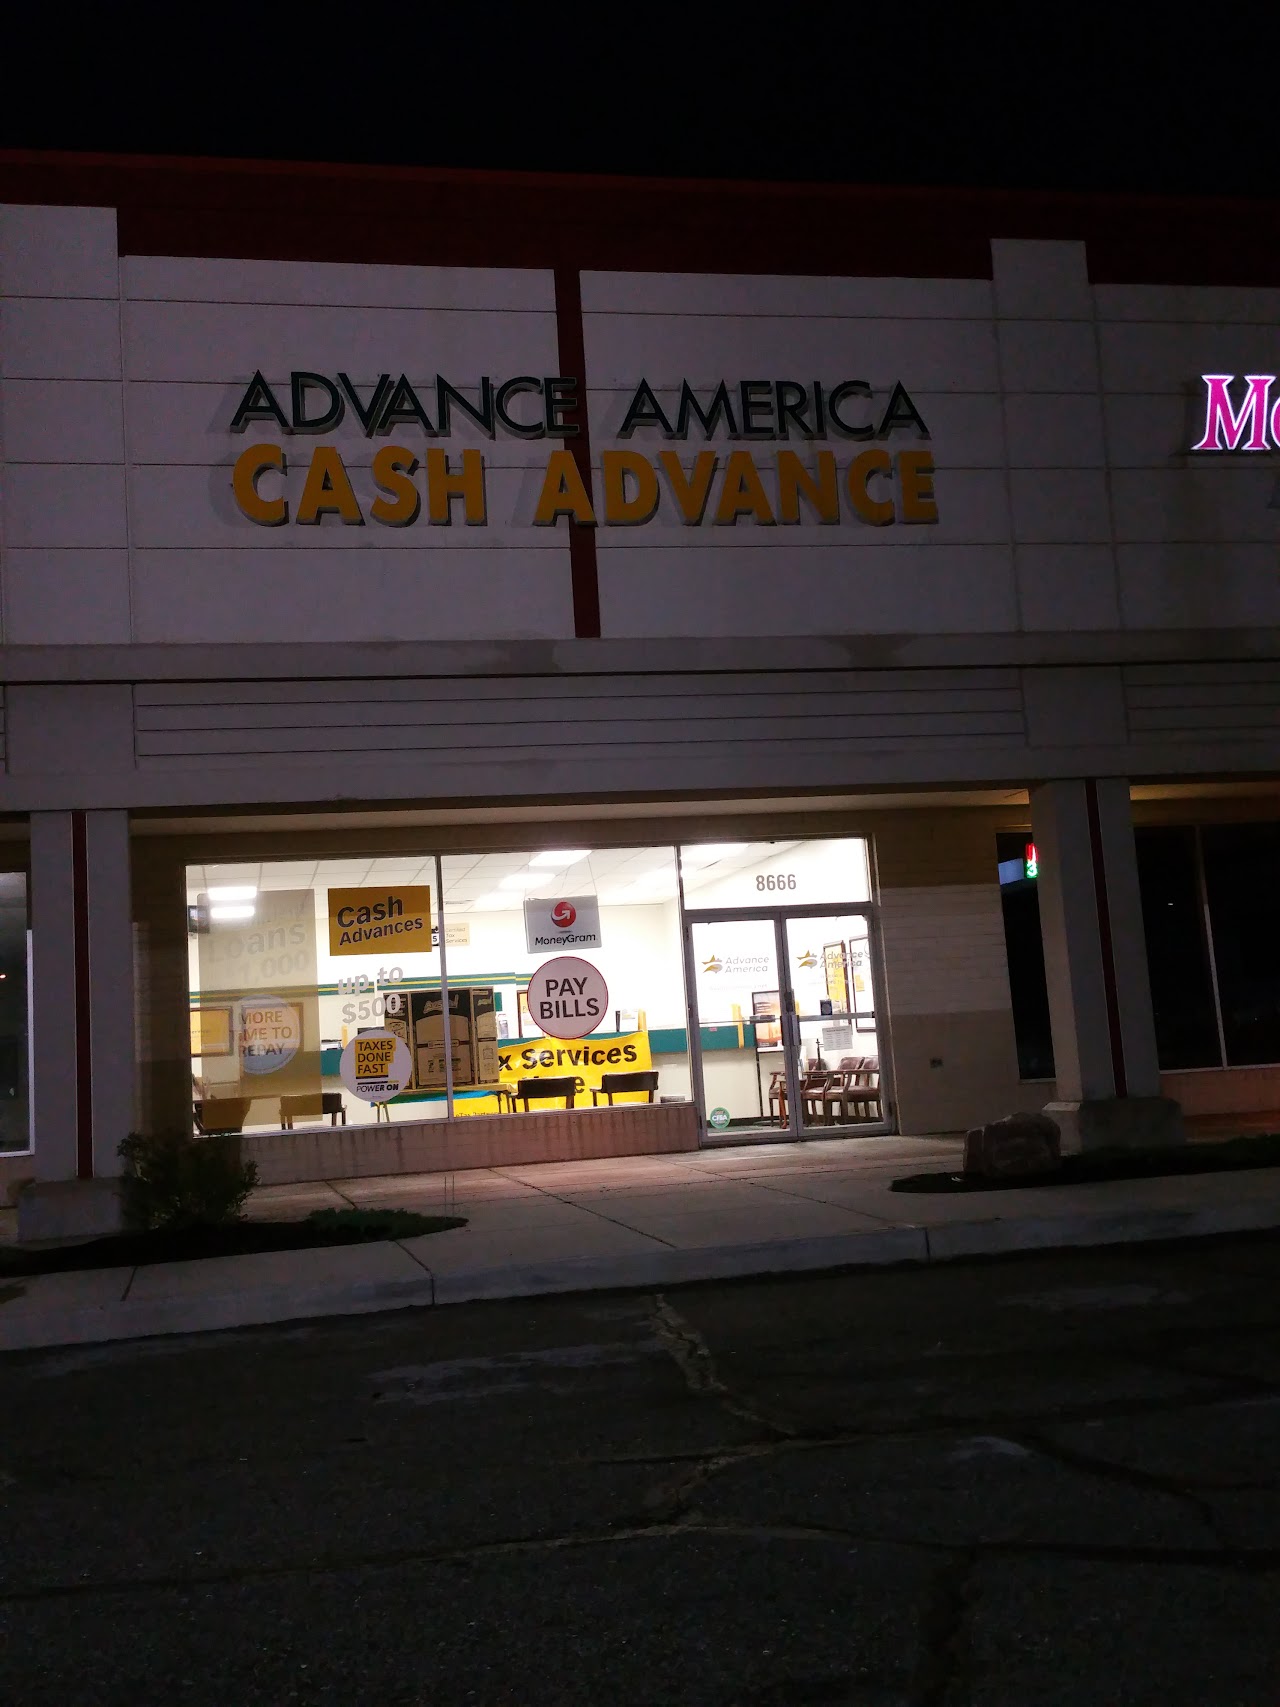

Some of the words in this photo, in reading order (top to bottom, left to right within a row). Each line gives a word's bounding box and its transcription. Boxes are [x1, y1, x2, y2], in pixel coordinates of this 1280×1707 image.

[230, 370, 580, 439] ADVANCE
[617, 376, 931, 441] AMERICA
[1190, 374, 1280, 450] M
[231, 443, 488, 528] CASH
[532, 447, 939, 528] ADVANCE
[755, 873, 797, 891] 8666
[337, 895, 403, 928] Cash
[339, 916, 424, 947] Advances
[534, 932, 596, 946] MoneyGram
[725, 955, 770, 965] Advance
[820, 950, 864, 961] Advance
[820, 958, 863, 969] America
[725, 964, 769, 974] America
[338, 973, 369, 996] up
[377, 966, 404, 986] to
[545, 977, 589, 997] PAY
[342, 993, 402, 1025] $500
[539, 997, 600, 1020] BILLS
[272, 1026, 293, 1039] TO
[357, 1040, 393, 1051] TAXES
[357, 1051, 391, 1063] DONE
[522, 1043, 638, 1070] Services
[357, 1063, 386, 1074] FAST
[356, 1084, 385, 1093] POWER
[386, 1083, 399, 1091] ON
